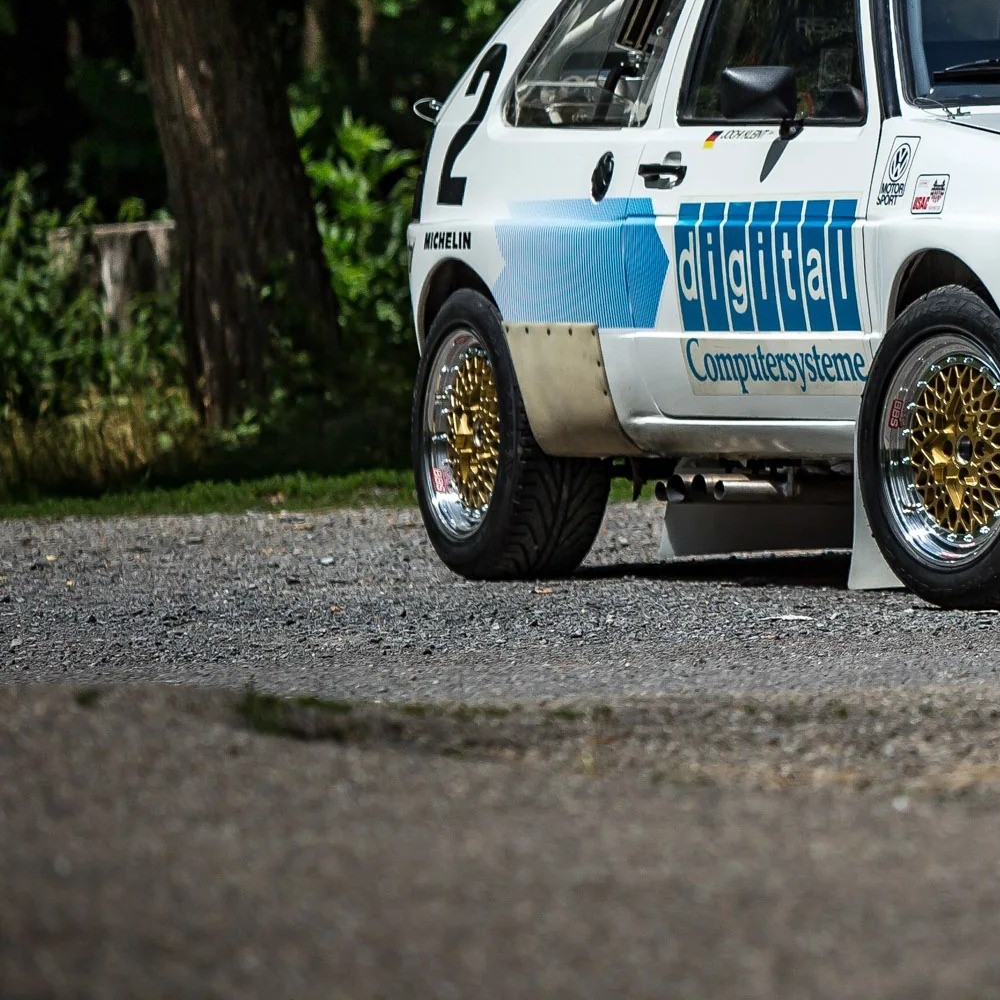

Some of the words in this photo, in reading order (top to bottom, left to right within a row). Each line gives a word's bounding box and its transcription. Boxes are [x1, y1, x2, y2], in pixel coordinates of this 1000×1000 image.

[436, 43, 508, 206] 2
[876, 194, 898, 206] SPORT
[881, 183, 905, 195] MOTOR
[424, 232, 472, 250] MICHELIN
[679, 229, 848, 315] digital
[686, 338, 869, 394] Computersysteme
